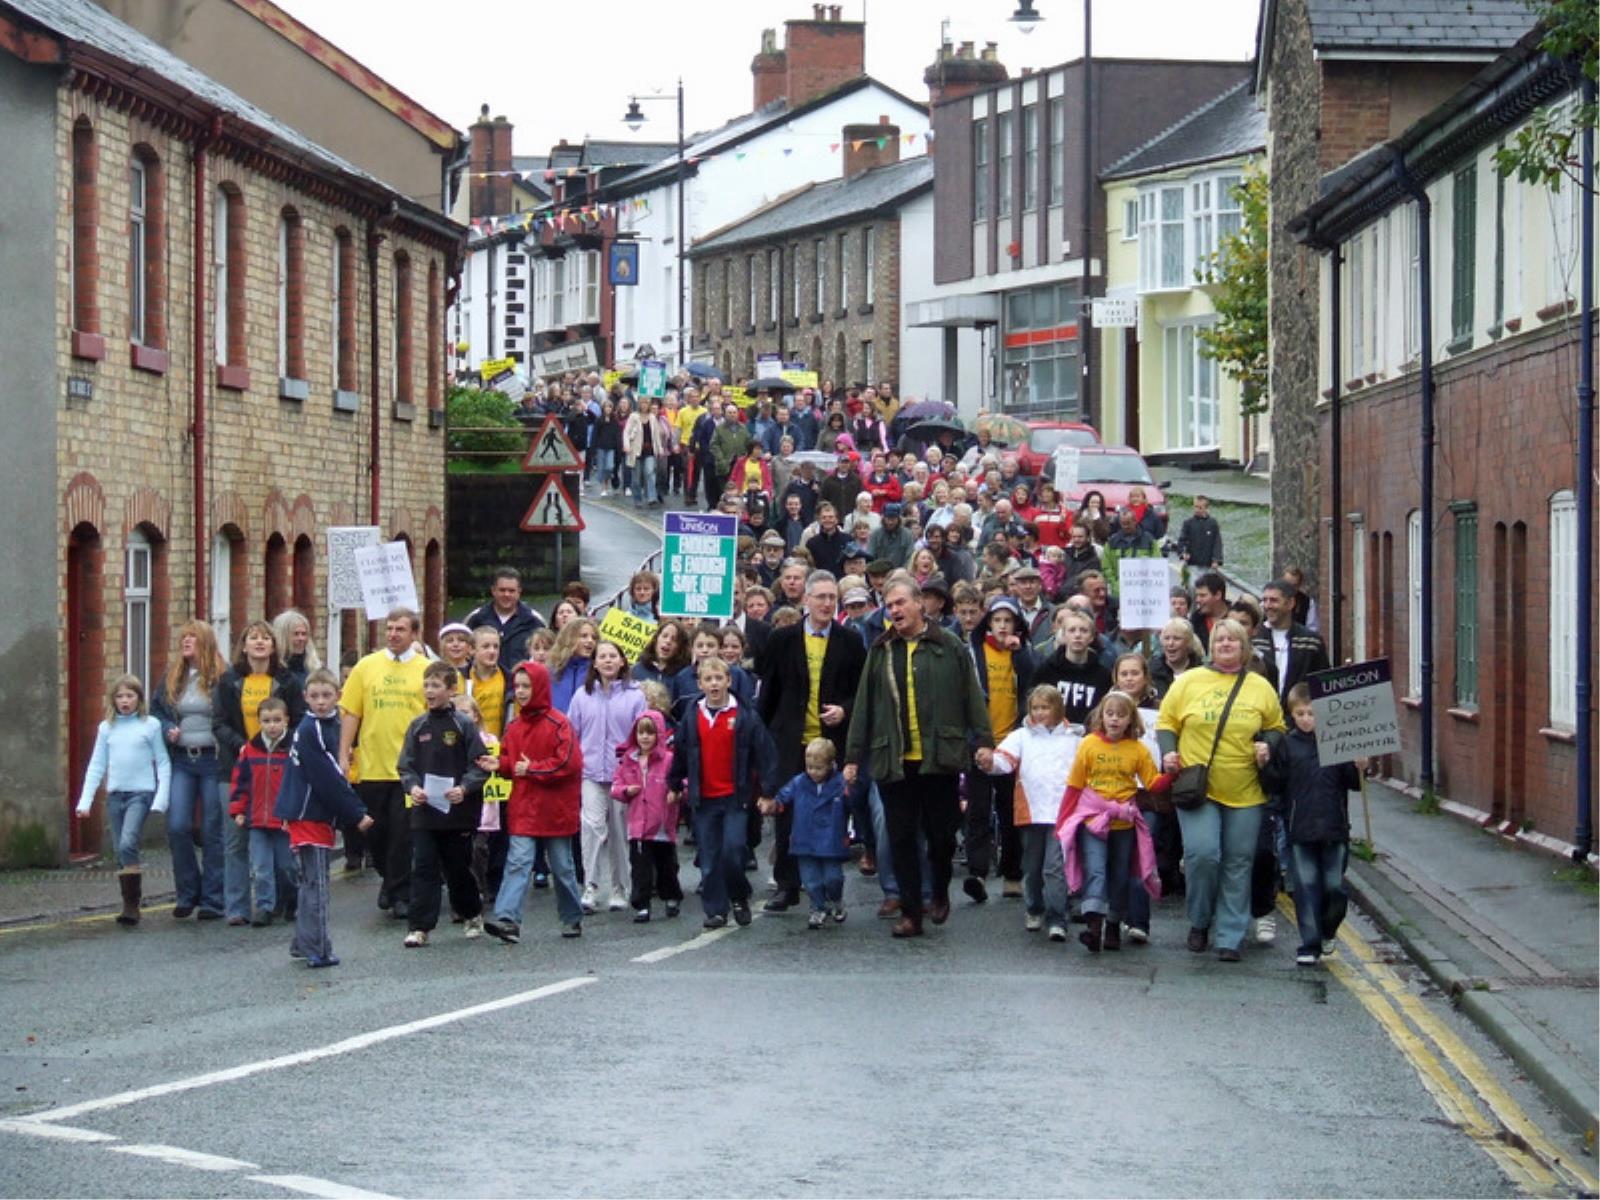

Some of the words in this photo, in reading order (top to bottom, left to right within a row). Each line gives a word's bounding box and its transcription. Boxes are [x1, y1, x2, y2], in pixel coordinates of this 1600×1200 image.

[681, 521, 719, 534] UNISON
[621, 616, 657, 637] SAV
[1321, 668, 1379, 693] UNISON
[1333, 736, 1397, 755] HOSPITAL
